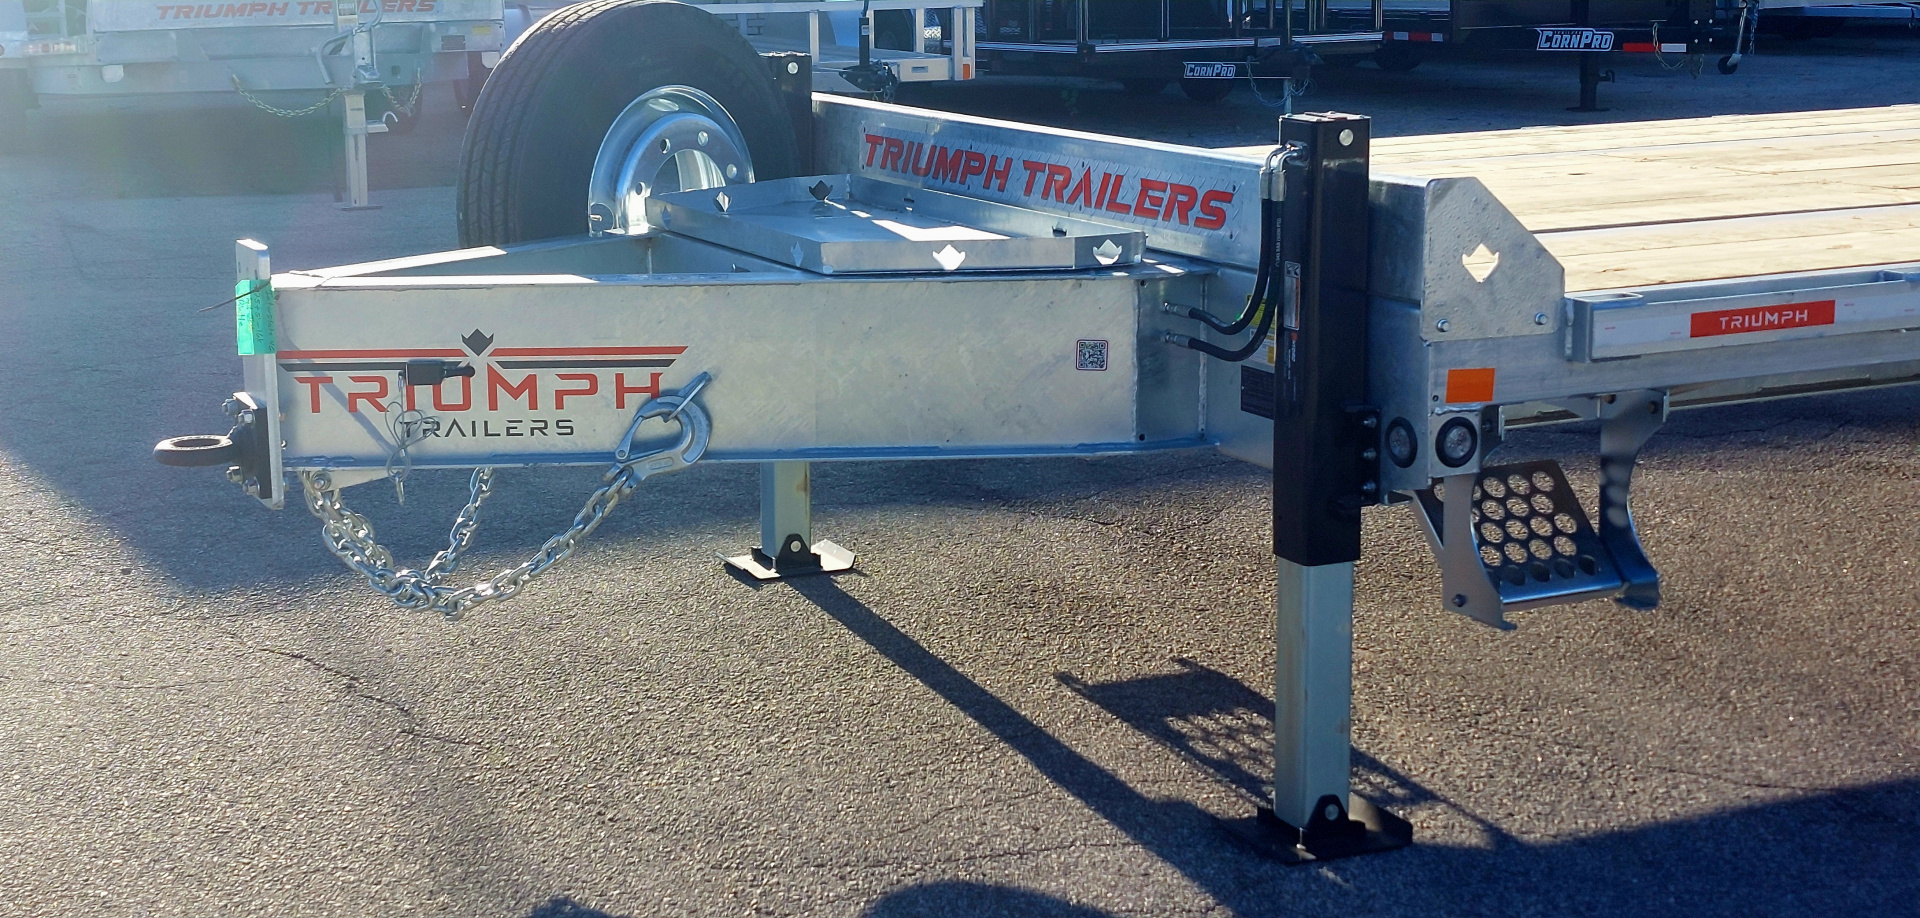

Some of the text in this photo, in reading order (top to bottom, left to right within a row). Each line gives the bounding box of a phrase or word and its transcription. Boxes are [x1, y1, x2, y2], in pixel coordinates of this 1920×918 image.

[156, 0, 437, 20] TRIUMPH TRLERS
[865, 134, 1234, 231] TRIUMPH TRAILERS
[1719, 310, 1808, 330] TRIUMPH
[293, 362, 663, 412] TRIUMPH
[399, 418, 575, 438] TRAILERS
